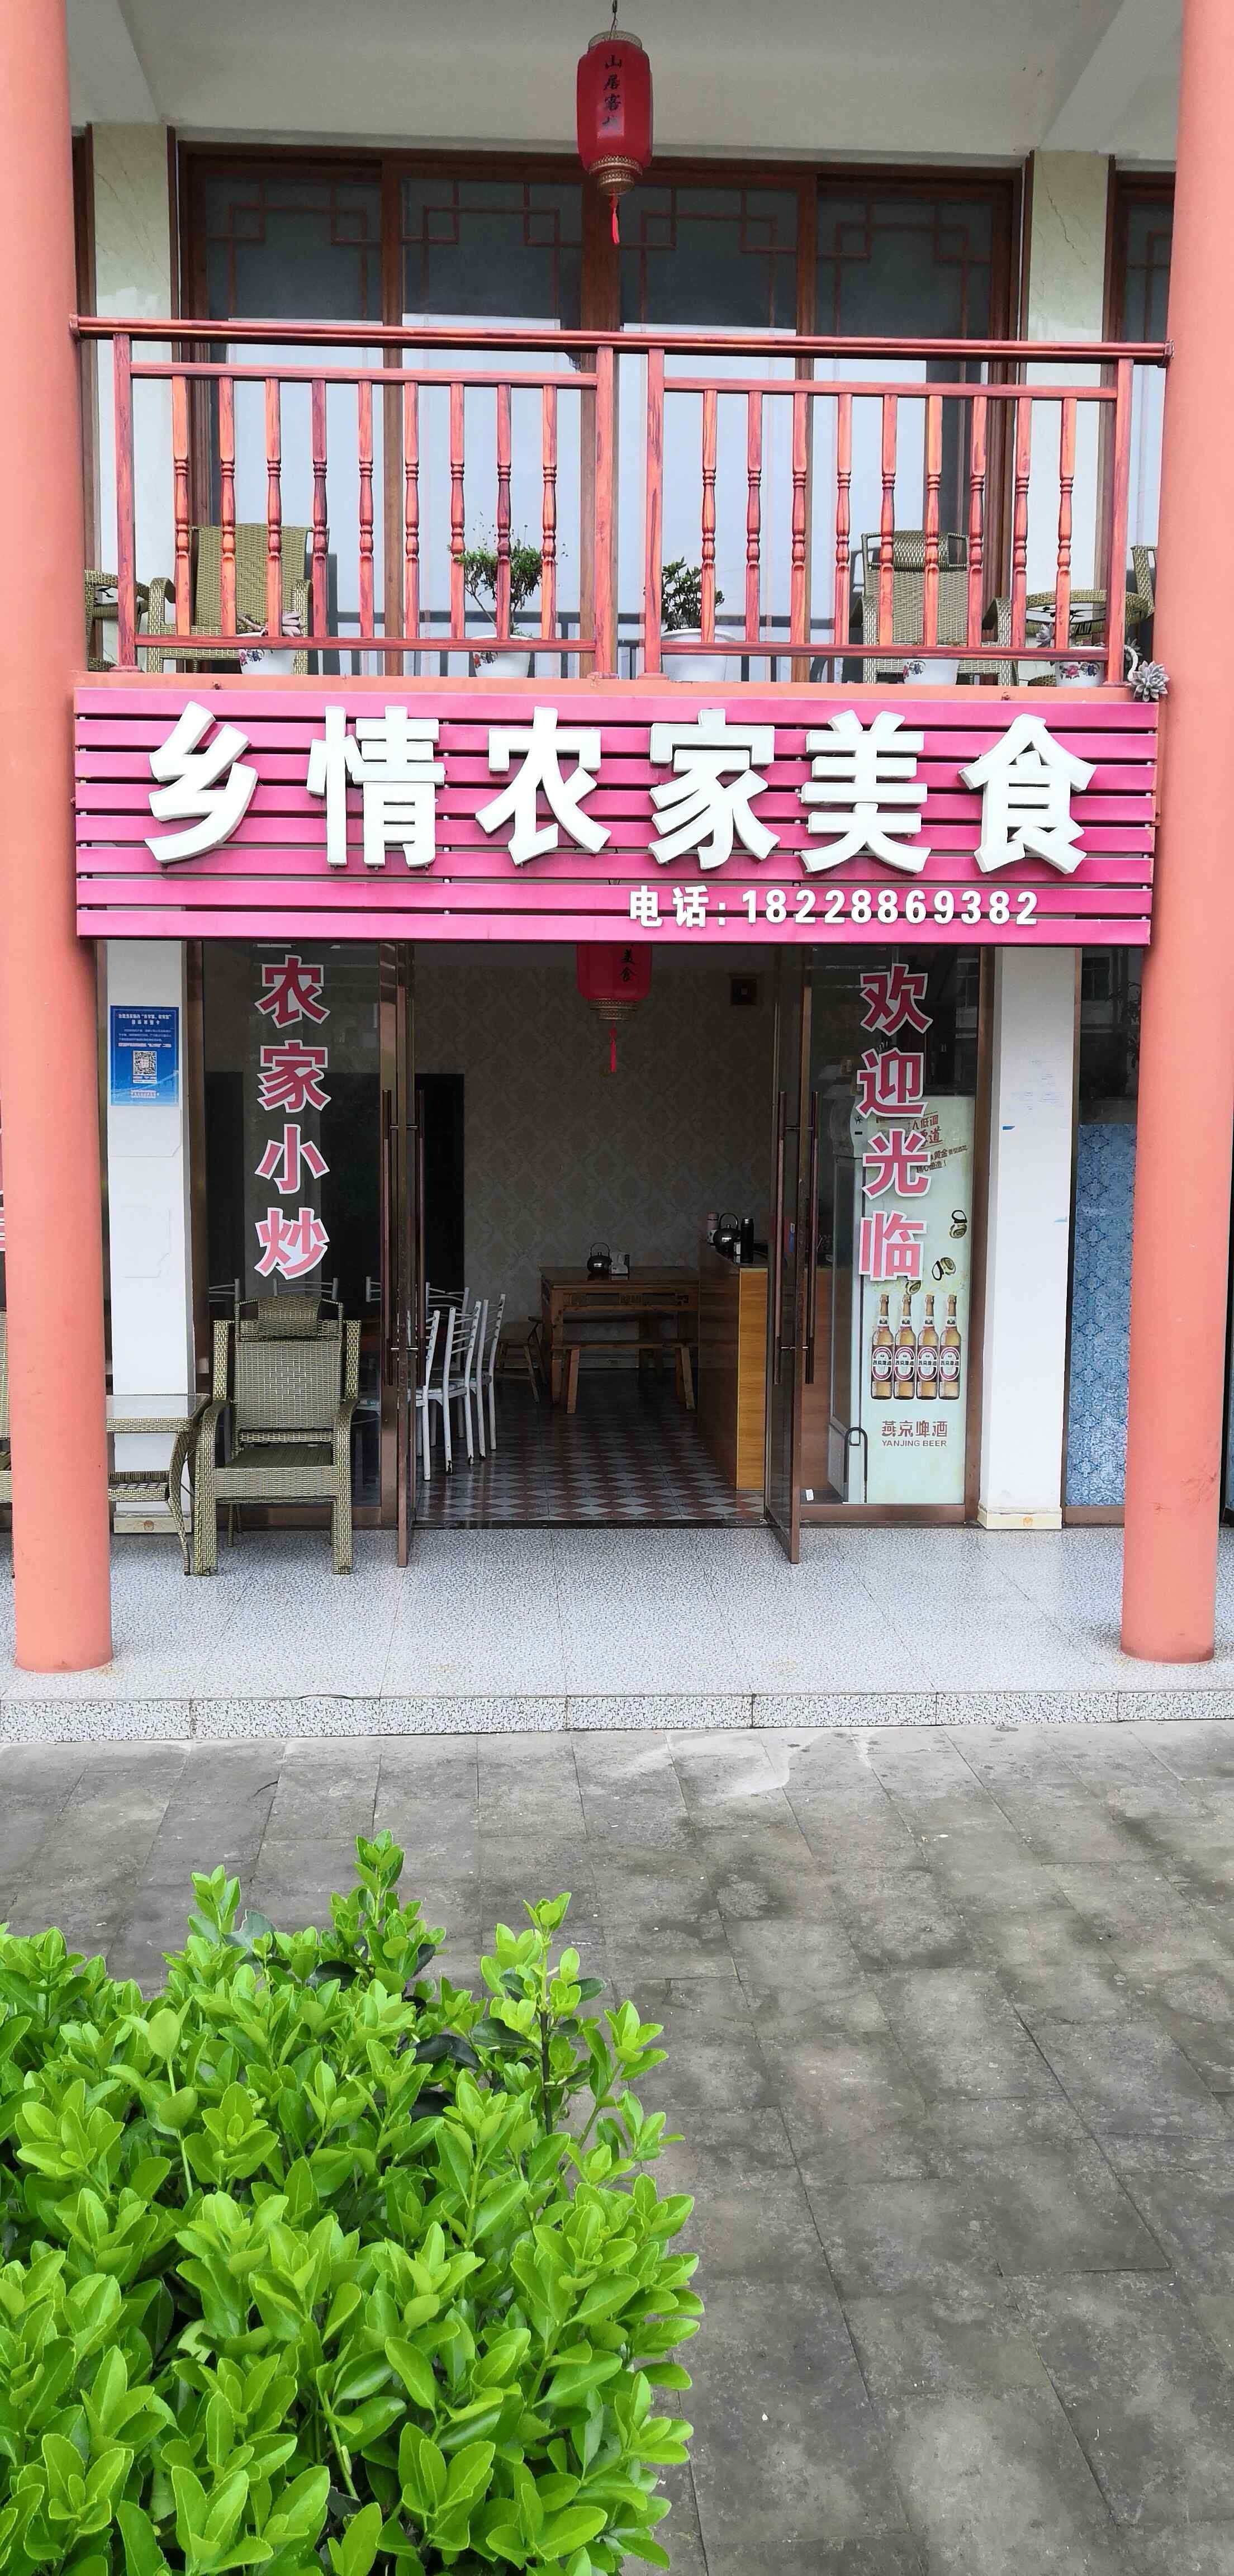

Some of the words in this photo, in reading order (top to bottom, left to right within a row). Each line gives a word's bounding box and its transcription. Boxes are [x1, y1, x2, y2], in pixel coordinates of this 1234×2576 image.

[602, 55, 622, 127] 山居客
[144, 700, 1097, 874] 乡情农家美食
[254, 954, 331, 1280] 农家小炒
[856, 963, 933, 1281] 欢迎光临
[881, 1420, 948, 1437] 燕京啤酒
